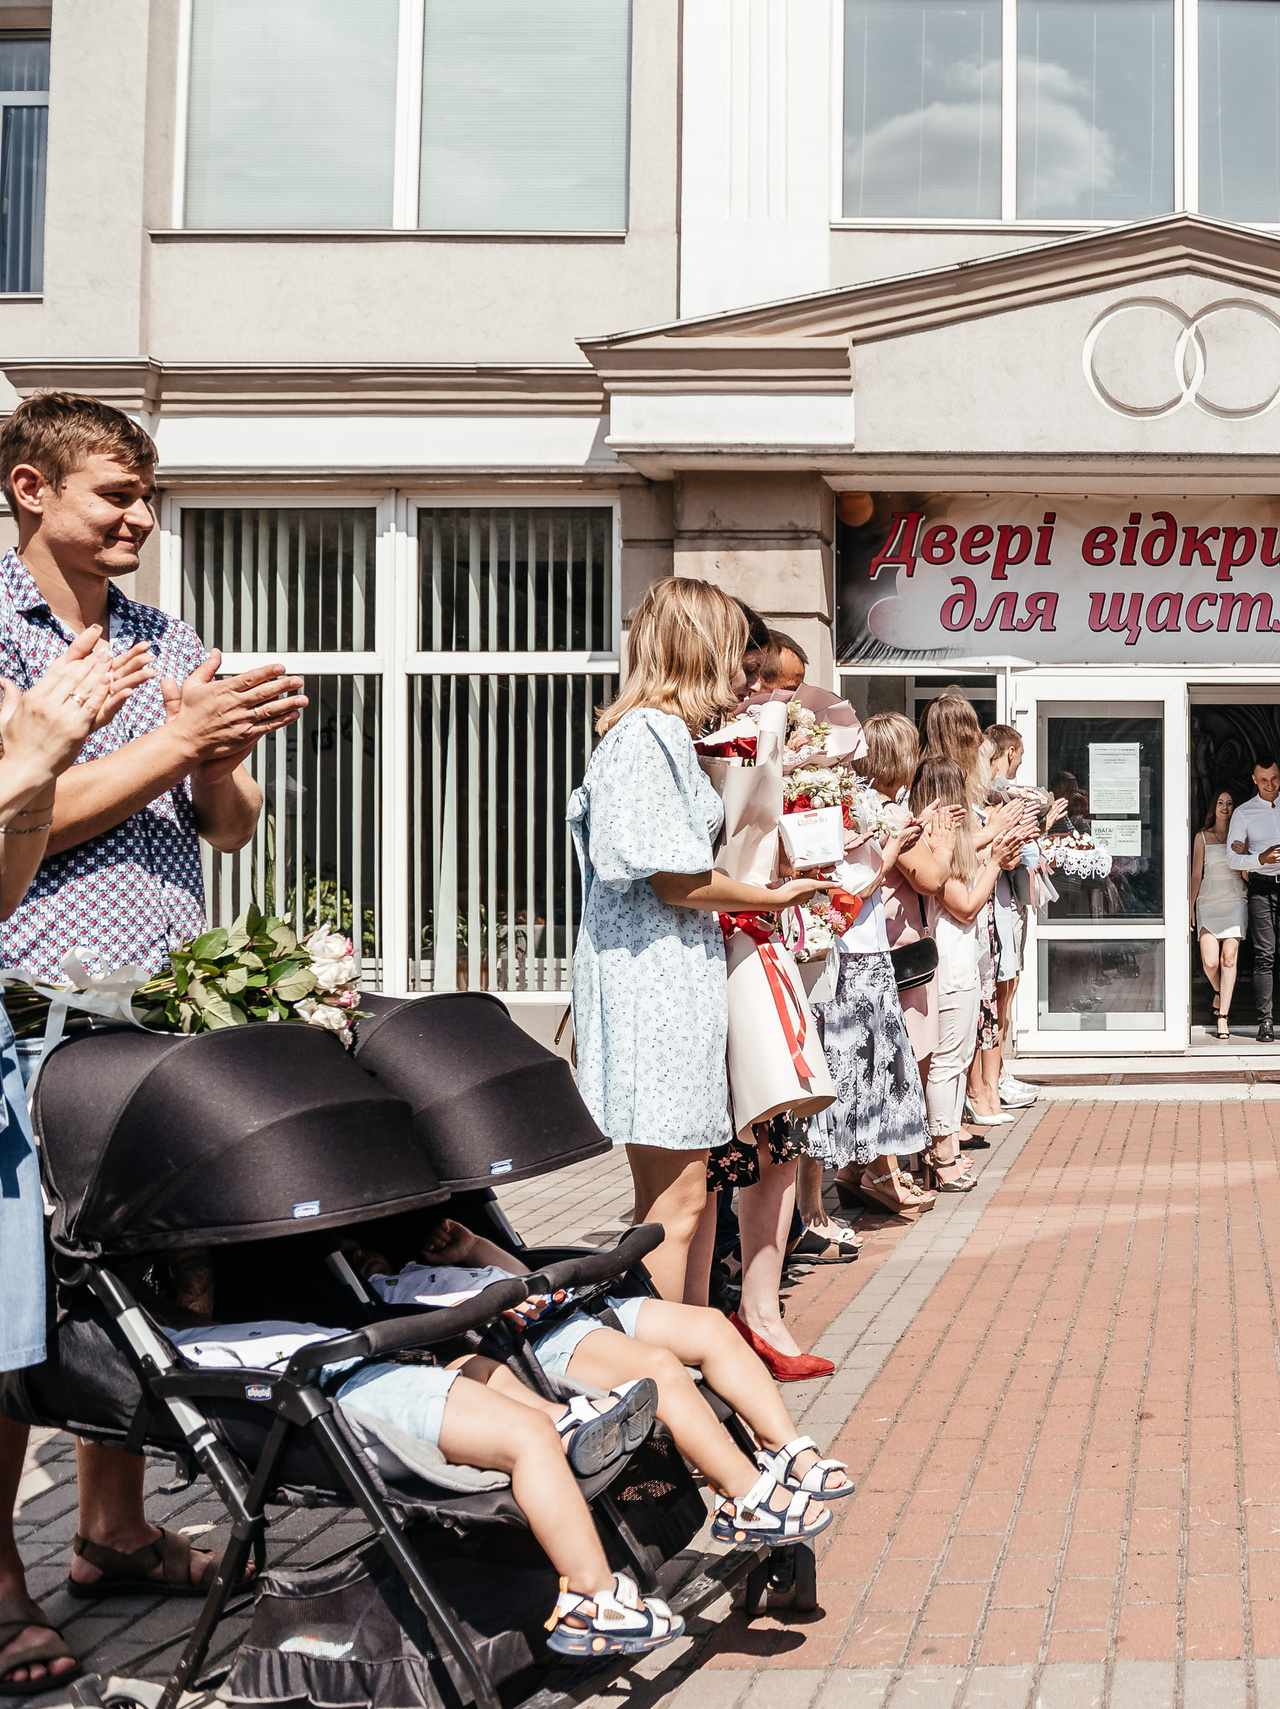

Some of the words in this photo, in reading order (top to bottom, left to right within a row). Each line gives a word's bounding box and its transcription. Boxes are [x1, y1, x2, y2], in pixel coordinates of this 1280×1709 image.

[869, 511, 1056, 580] Двері
[940, 576, 1059, 631] для
[797, 816, 827, 827] Raffaello
